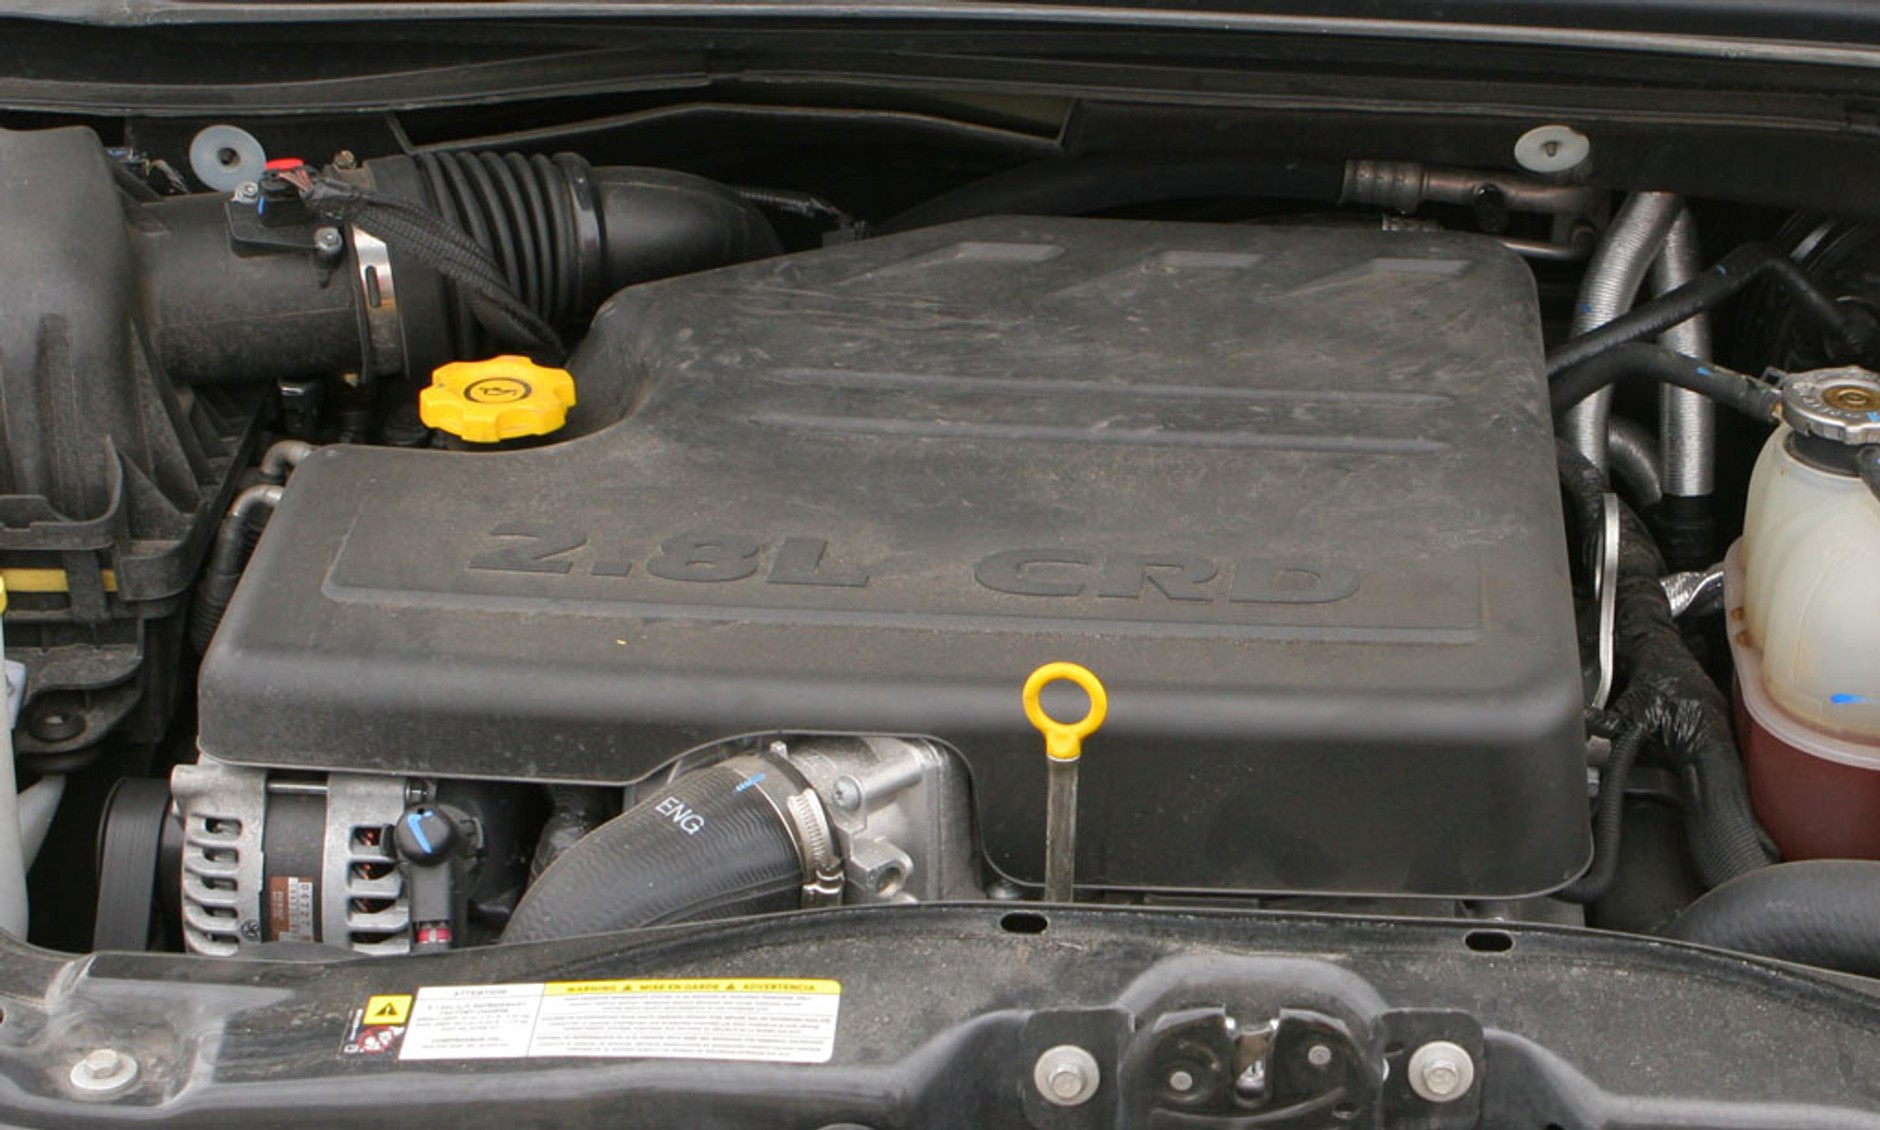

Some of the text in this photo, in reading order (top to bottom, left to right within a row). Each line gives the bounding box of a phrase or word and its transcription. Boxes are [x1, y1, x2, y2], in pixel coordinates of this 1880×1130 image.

[468, 523, 1362, 604] 2.8L CRD
[655, 796, 705, 836] ENG
[684, 983, 719, 991] GARDE
[742, 984, 816, 992] ADVERTENCIA
